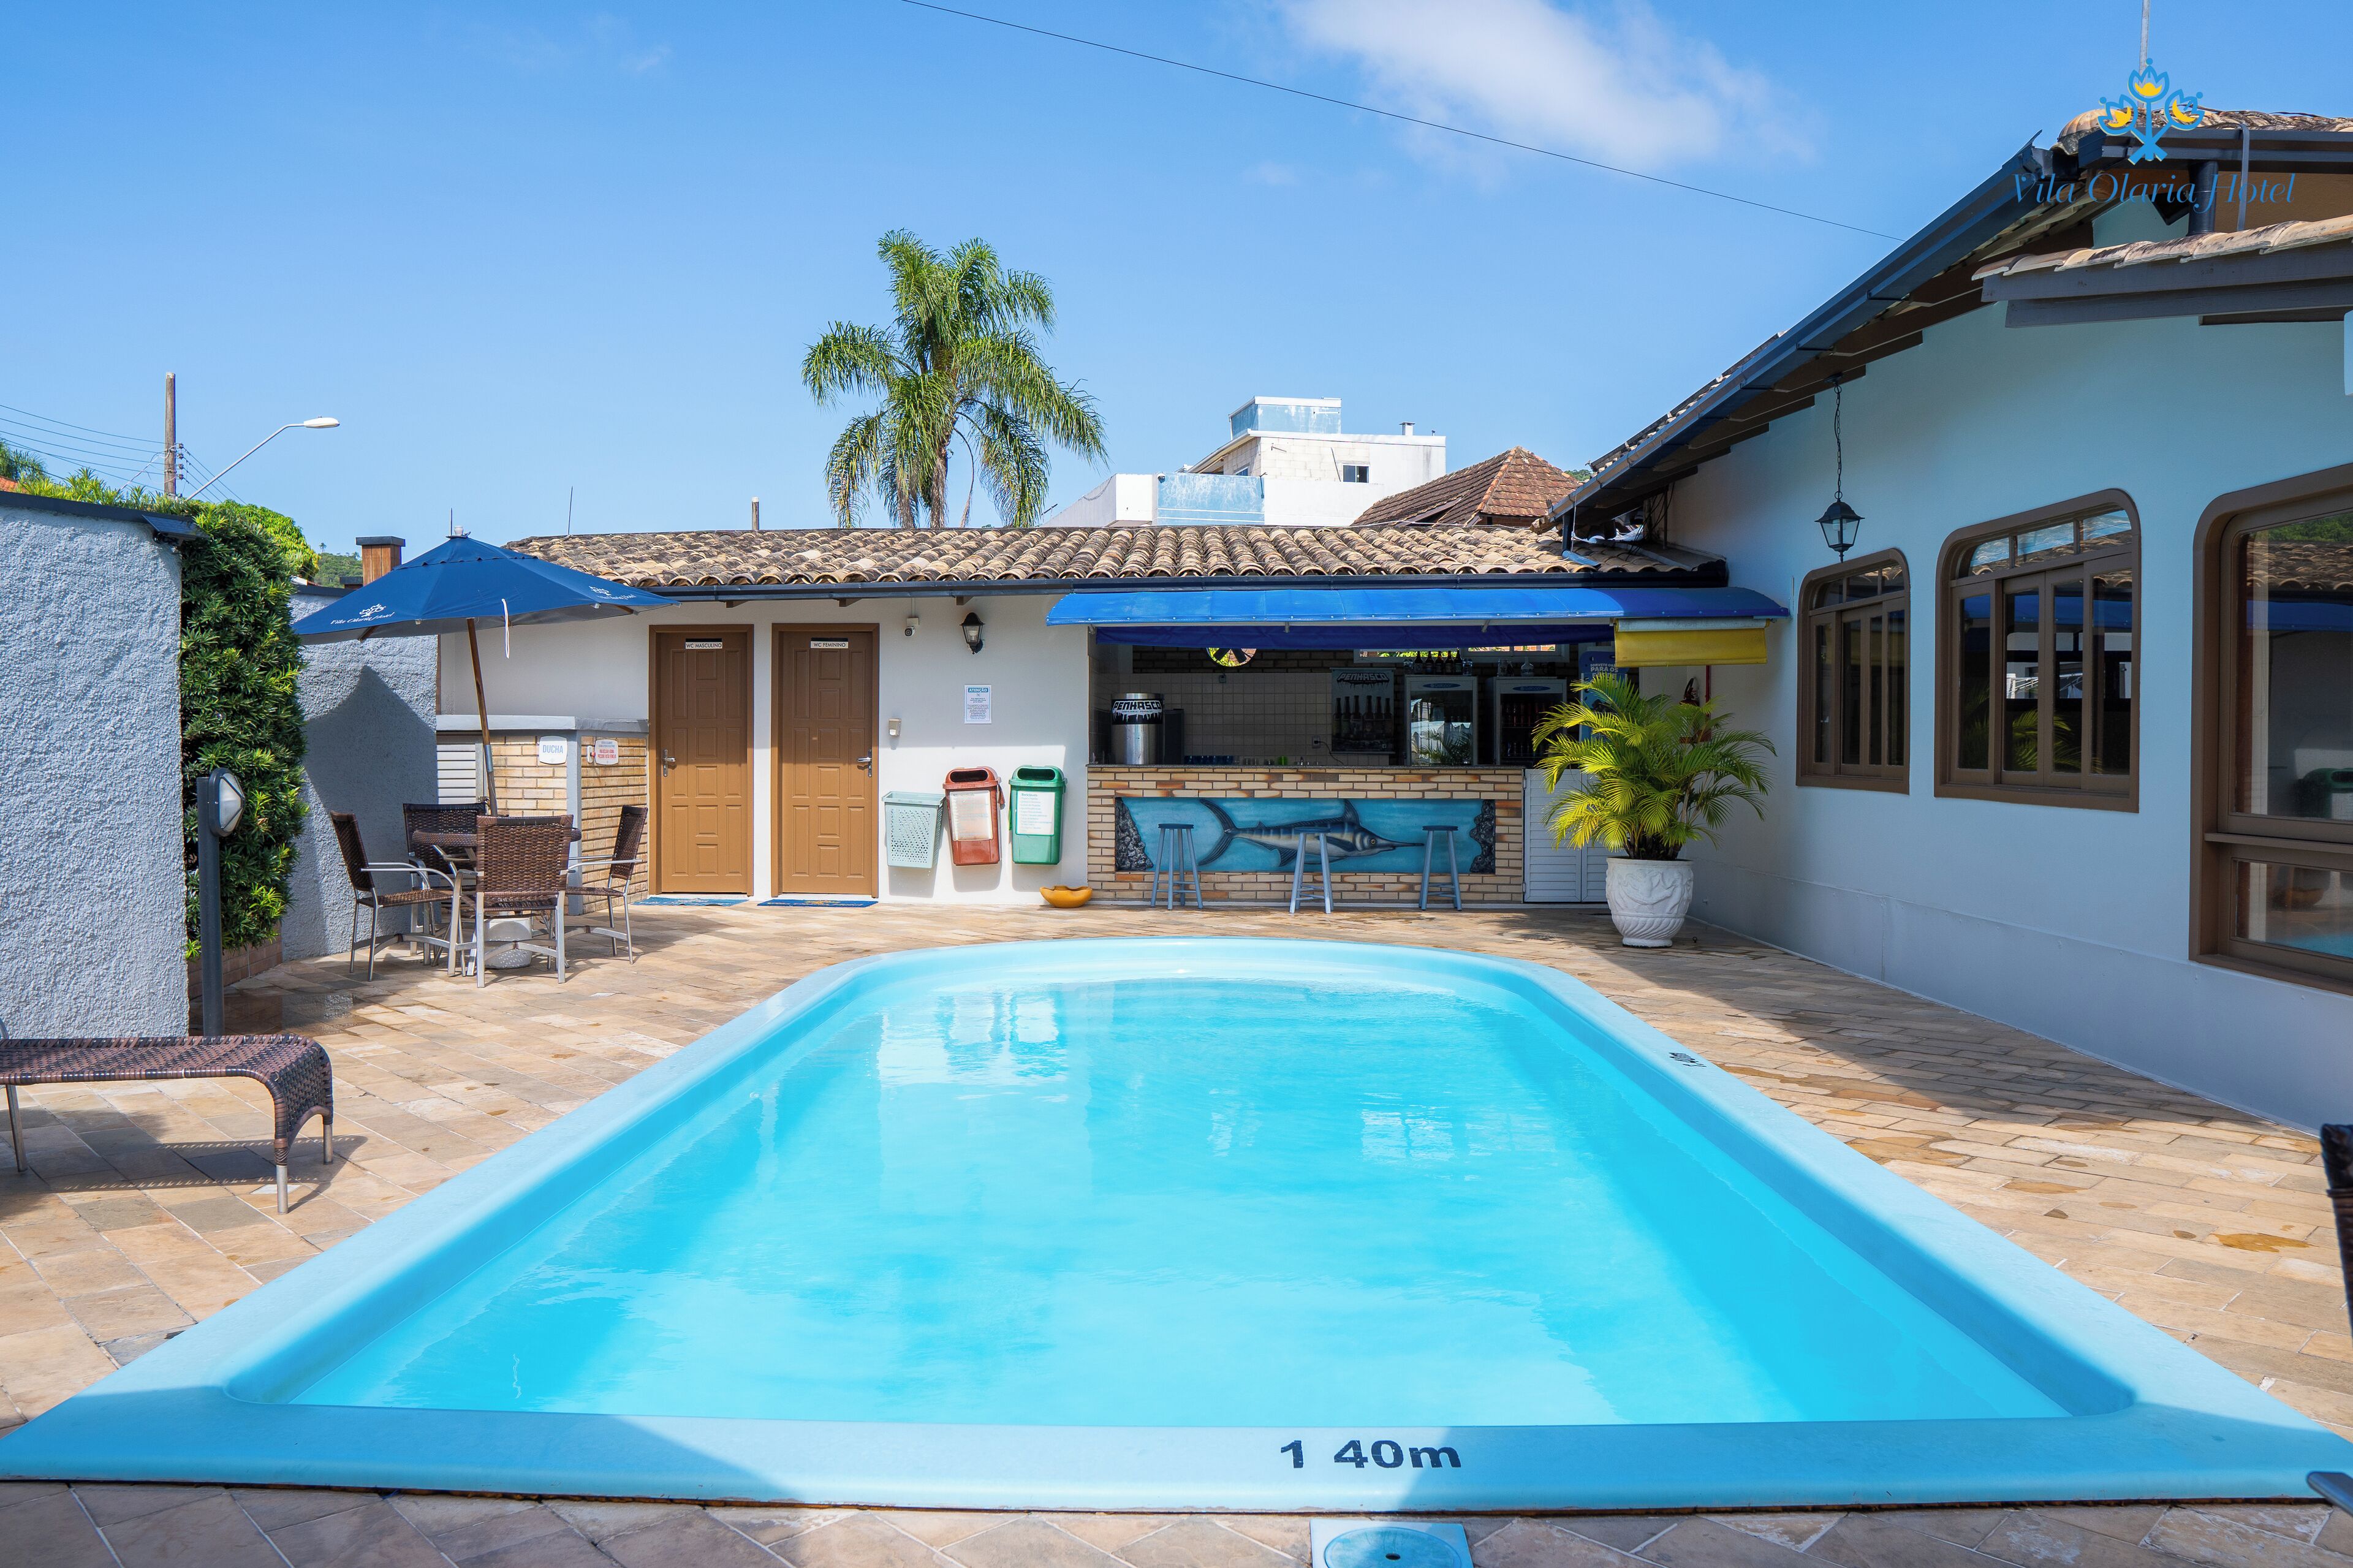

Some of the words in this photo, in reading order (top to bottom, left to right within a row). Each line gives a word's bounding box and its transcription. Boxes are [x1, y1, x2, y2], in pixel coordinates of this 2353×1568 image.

[1336, 672, 1389, 681] PENHASCO
[1112, 700, 1162, 711] PENHASCO
[542, 744, 564, 754] DUCHA
[1281, 1440, 1304, 1468] 1
[1333, 1440, 1461, 1468] 40m
